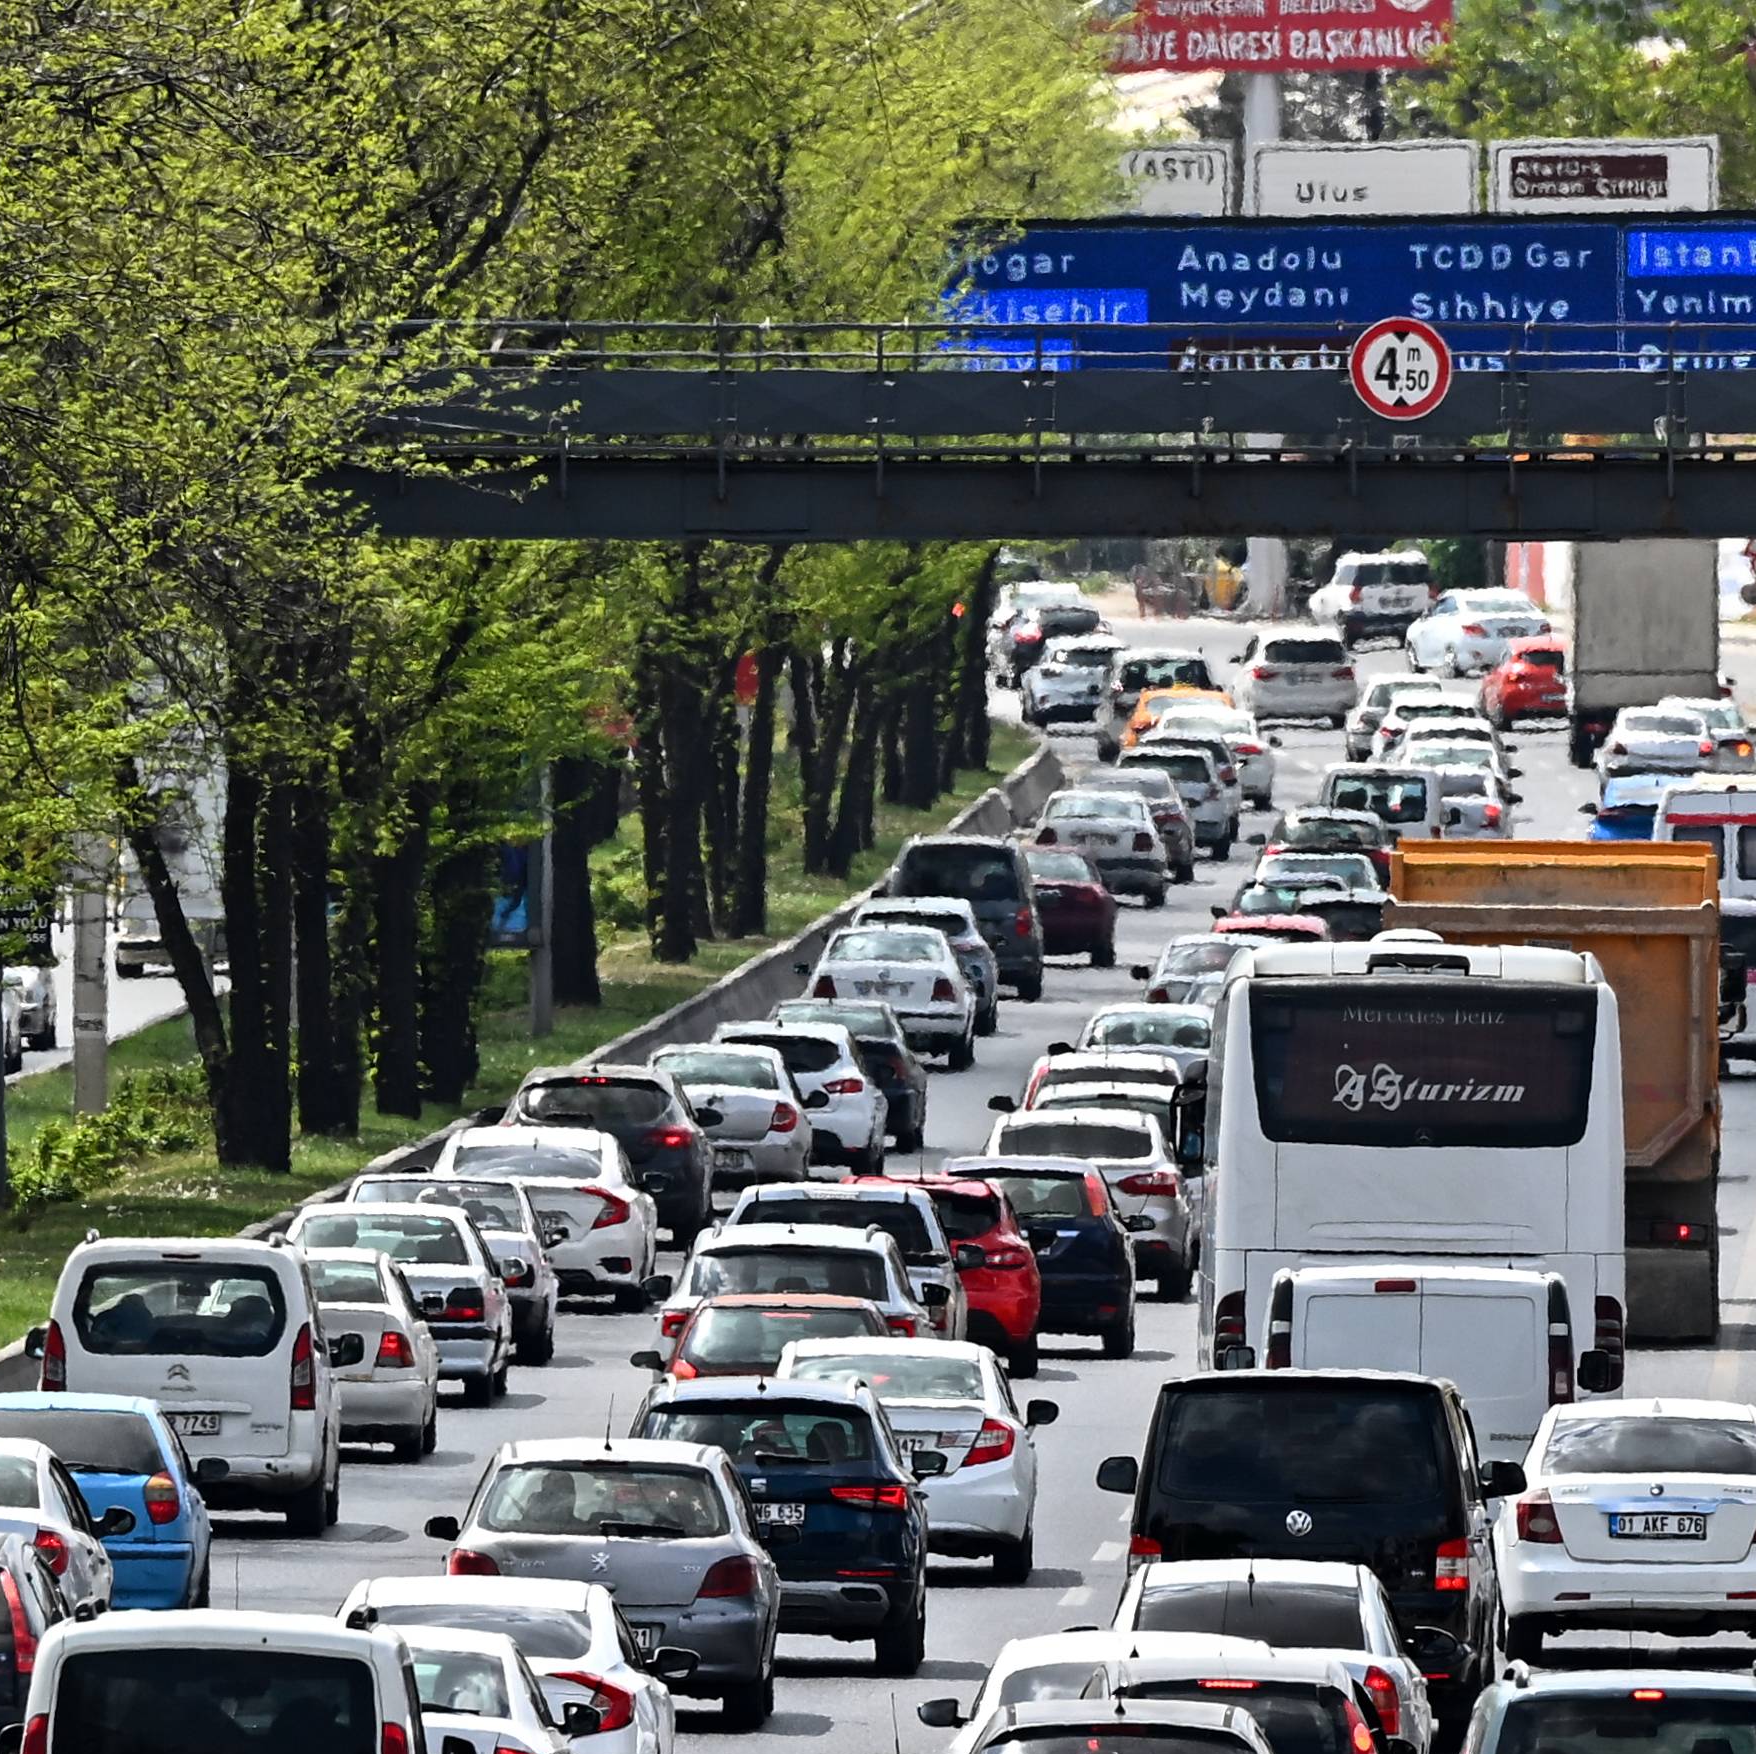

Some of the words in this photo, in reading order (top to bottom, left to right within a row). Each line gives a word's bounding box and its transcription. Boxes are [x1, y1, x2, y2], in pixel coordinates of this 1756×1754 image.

[1187, 25, 1281, 61] DAİRESİ
[1296, 181, 1369, 203] Ulus
[1177, 245, 1343, 272] Anadolu
[1409, 242, 1512, 271] TCDD
[1525, 242, 1592, 270] Gar
[1180, 281, 1350, 314] Meydanı
[183, 1414, 219, 1433] 7749
[777, 1503, 804, 1520] 635
[1618, 1517, 1634, 1532] 01
[1642, 1517, 1669, 1533] AKF
[1677, 1517, 1704, 1533] 676
